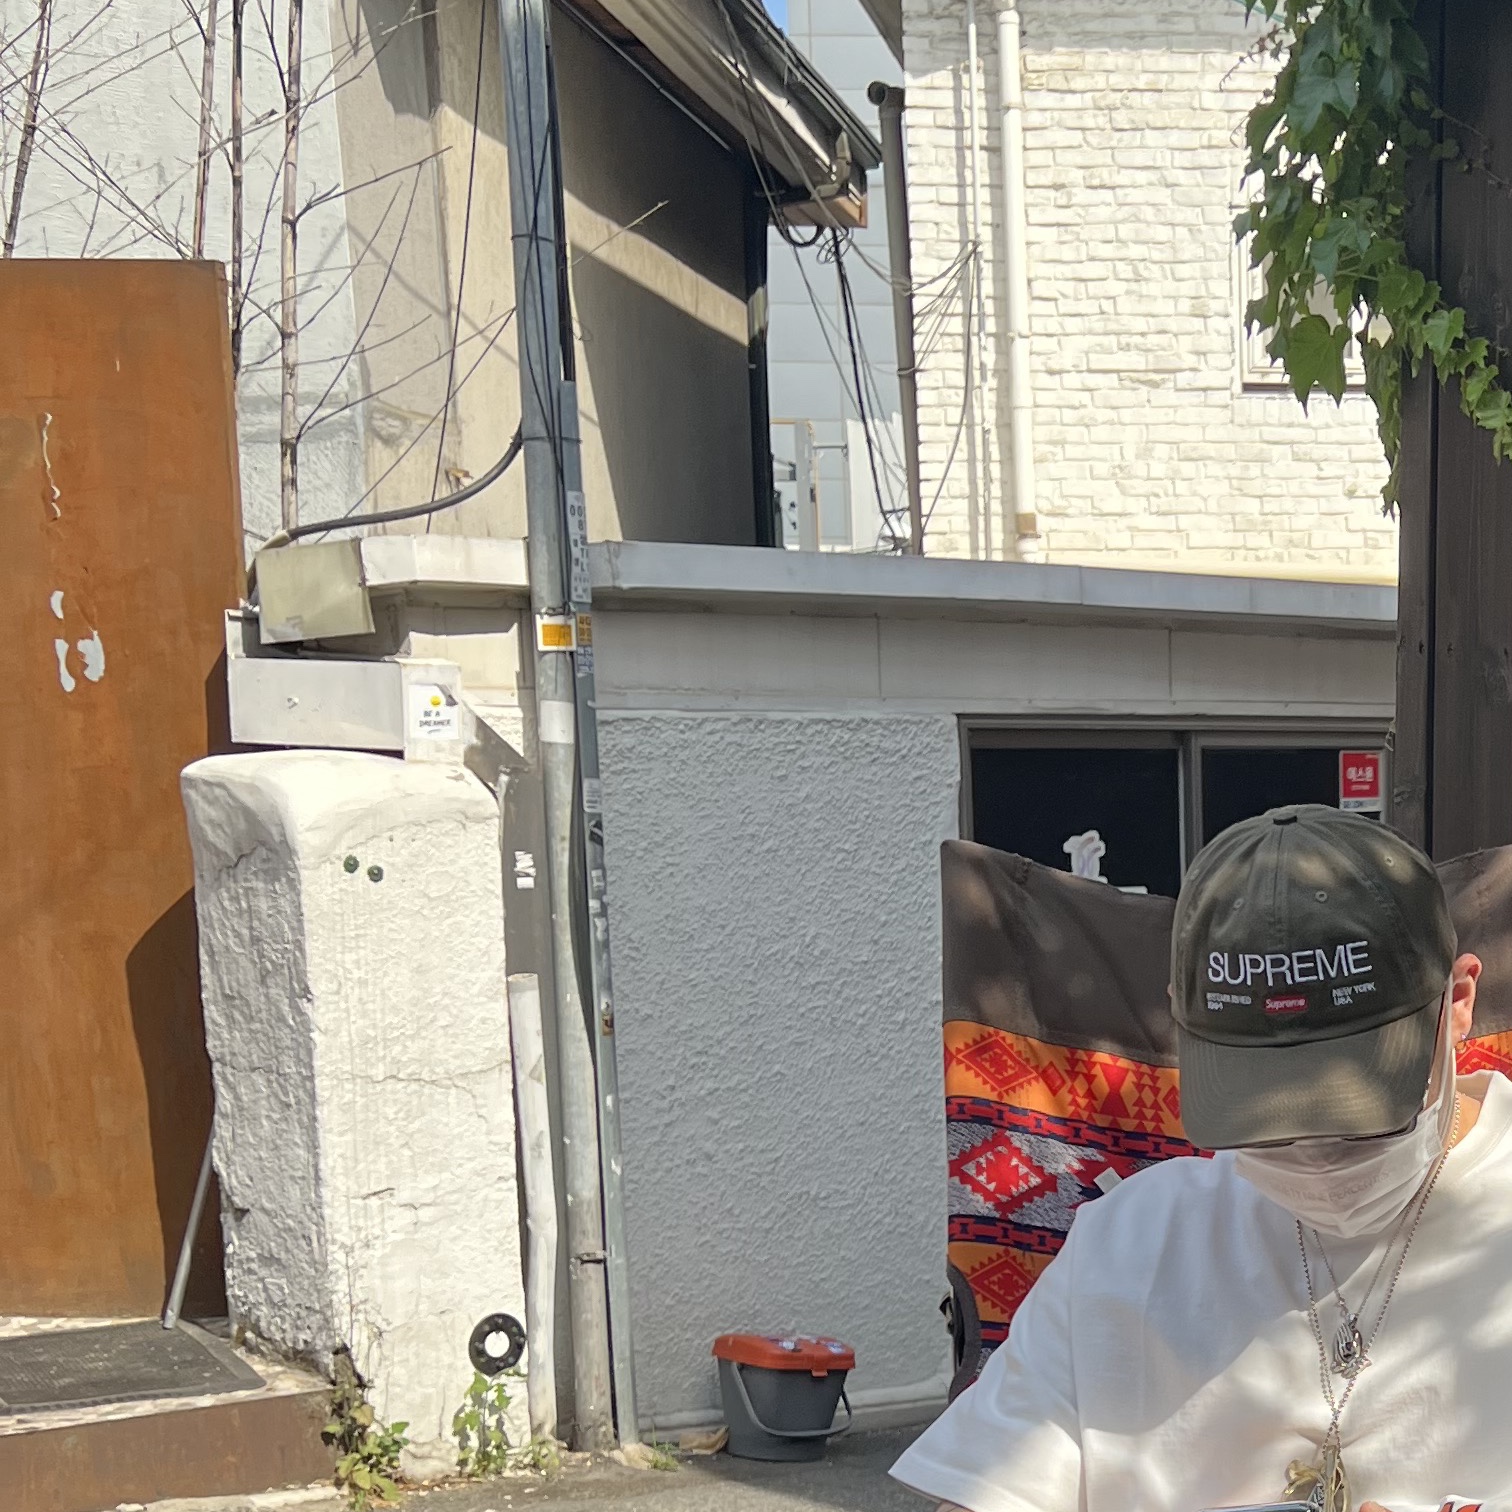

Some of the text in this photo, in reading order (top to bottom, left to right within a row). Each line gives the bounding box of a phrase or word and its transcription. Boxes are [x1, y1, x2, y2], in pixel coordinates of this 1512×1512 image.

[423, 709, 441, 718] BE A
[1207, 940, 1373, 987] SUPREME
[1353, 981, 1377, 995] YORK
[1265, 998, 1306, 1011] Supreme
[1333, 995, 1354, 1006] USA
